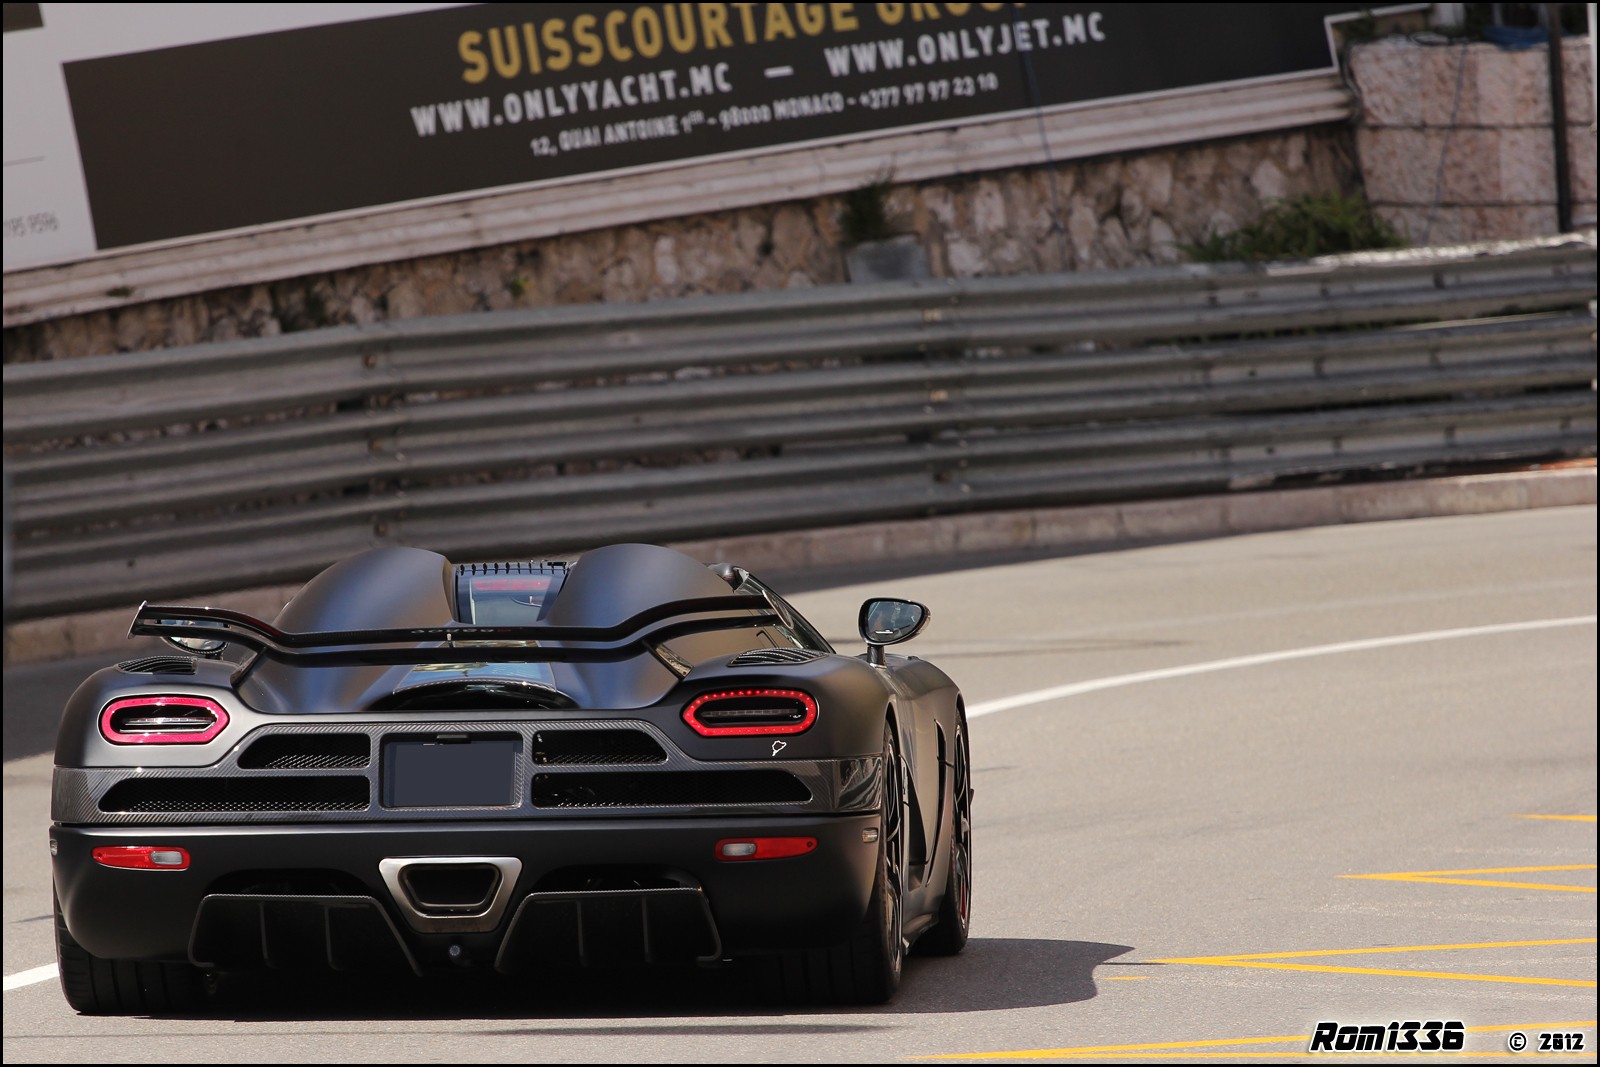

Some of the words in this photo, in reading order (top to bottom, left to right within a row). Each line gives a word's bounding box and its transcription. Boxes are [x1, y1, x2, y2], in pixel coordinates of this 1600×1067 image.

[410, 62, 733, 137] WWW.ONLYYACHT.MC
[824, 12, 1106, 77] WWW.ONLYJET.MC
[458, 3, 859, 84] SUISSCOURTAGE
[558, 126, 601, 151] QUAI
[602, 116, 679, 145] ANTOINE
[718, 104, 772, 131] 98000
[773, 92, 845, 120] MONACO
[858, 86, 901, 110] +377
[902, 82, 926, 105] 97
[927, 79, 951, 101] 97
[952, 76, 977, 97] 23
